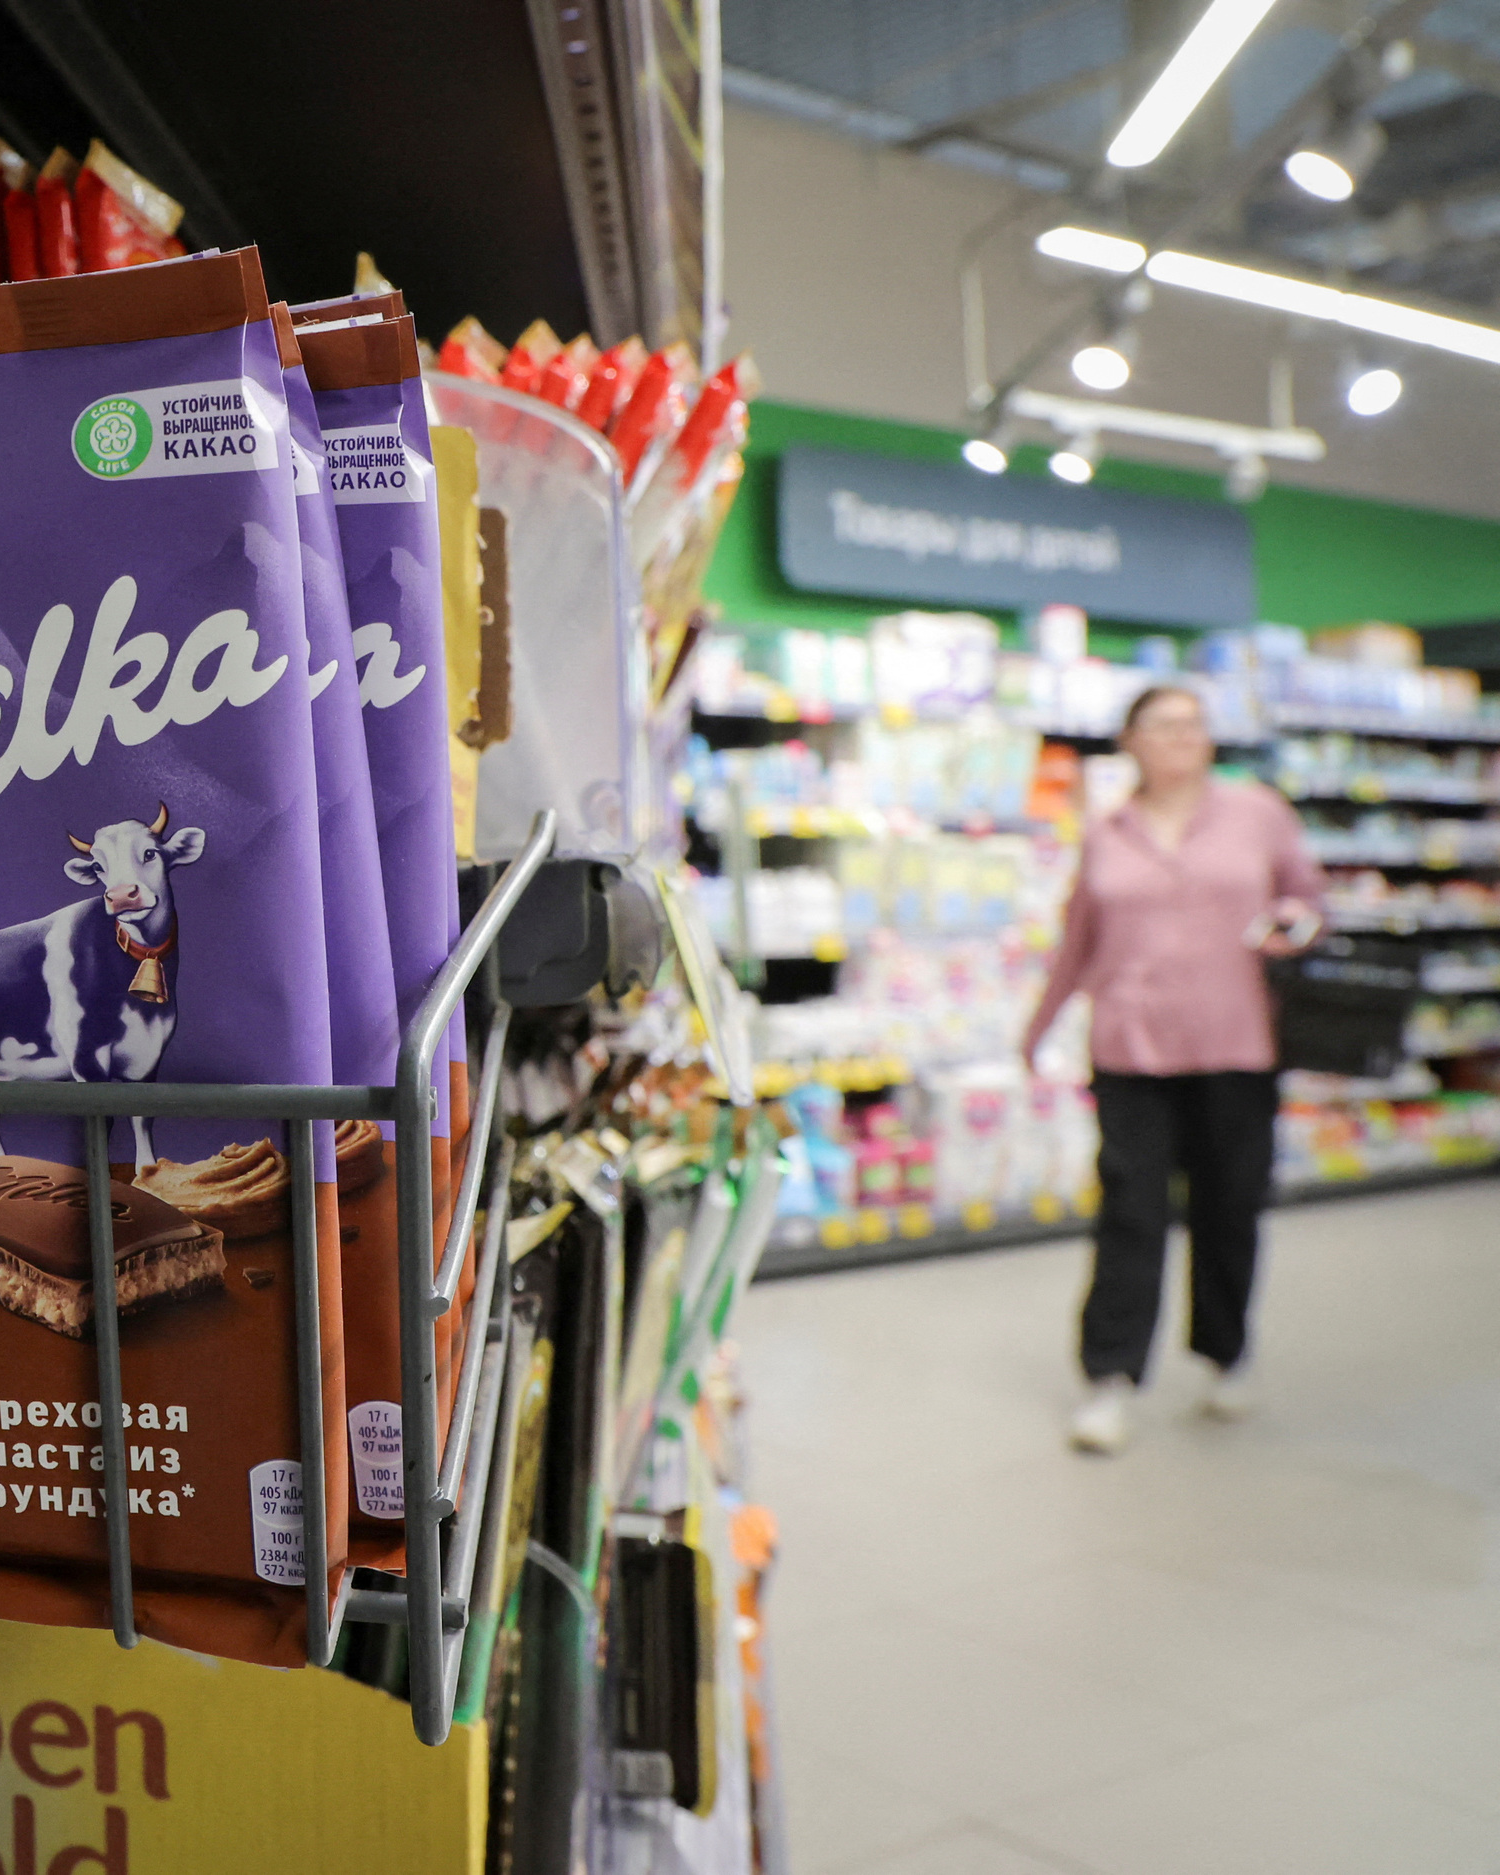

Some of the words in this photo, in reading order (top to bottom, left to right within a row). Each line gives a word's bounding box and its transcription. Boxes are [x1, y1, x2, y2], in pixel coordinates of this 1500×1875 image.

[91, 401, 136, 419] COCOA
[163, 394, 246, 416] УСТОЙЧИВ
[163, 414, 255, 435] ВЫРАЩЕННОЕ
[164, 434, 257, 460] КАКАО
[97, 459, 131, 473] LIFE
[368, 1411, 381, 1422] 17
[358, 1426, 377, 1439] 405
[362, 1441, 375, 1453] 97
[378, 1444, 400, 1453] ккал
[130, 1446, 181, 1474] из
[272, 1469, 285, 1482] 17
[371, 1469, 391, 1481] 100
[259, 1486, 281, 1499] 405
[362, 1486, 388, 1498] 2384
[391, 1487, 404, 1499] кД
[263, 1502, 277, 1515] 97
[366, 1500, 386, 1511] 572
[388, 1502, 405, 1511] кка
[271, 1532, 292, 1545] 100
[260, 1549, 288, 1561] 2384
[264, 1565, 285, 1577] 572
[287, 1568, 305, 1578] кка
